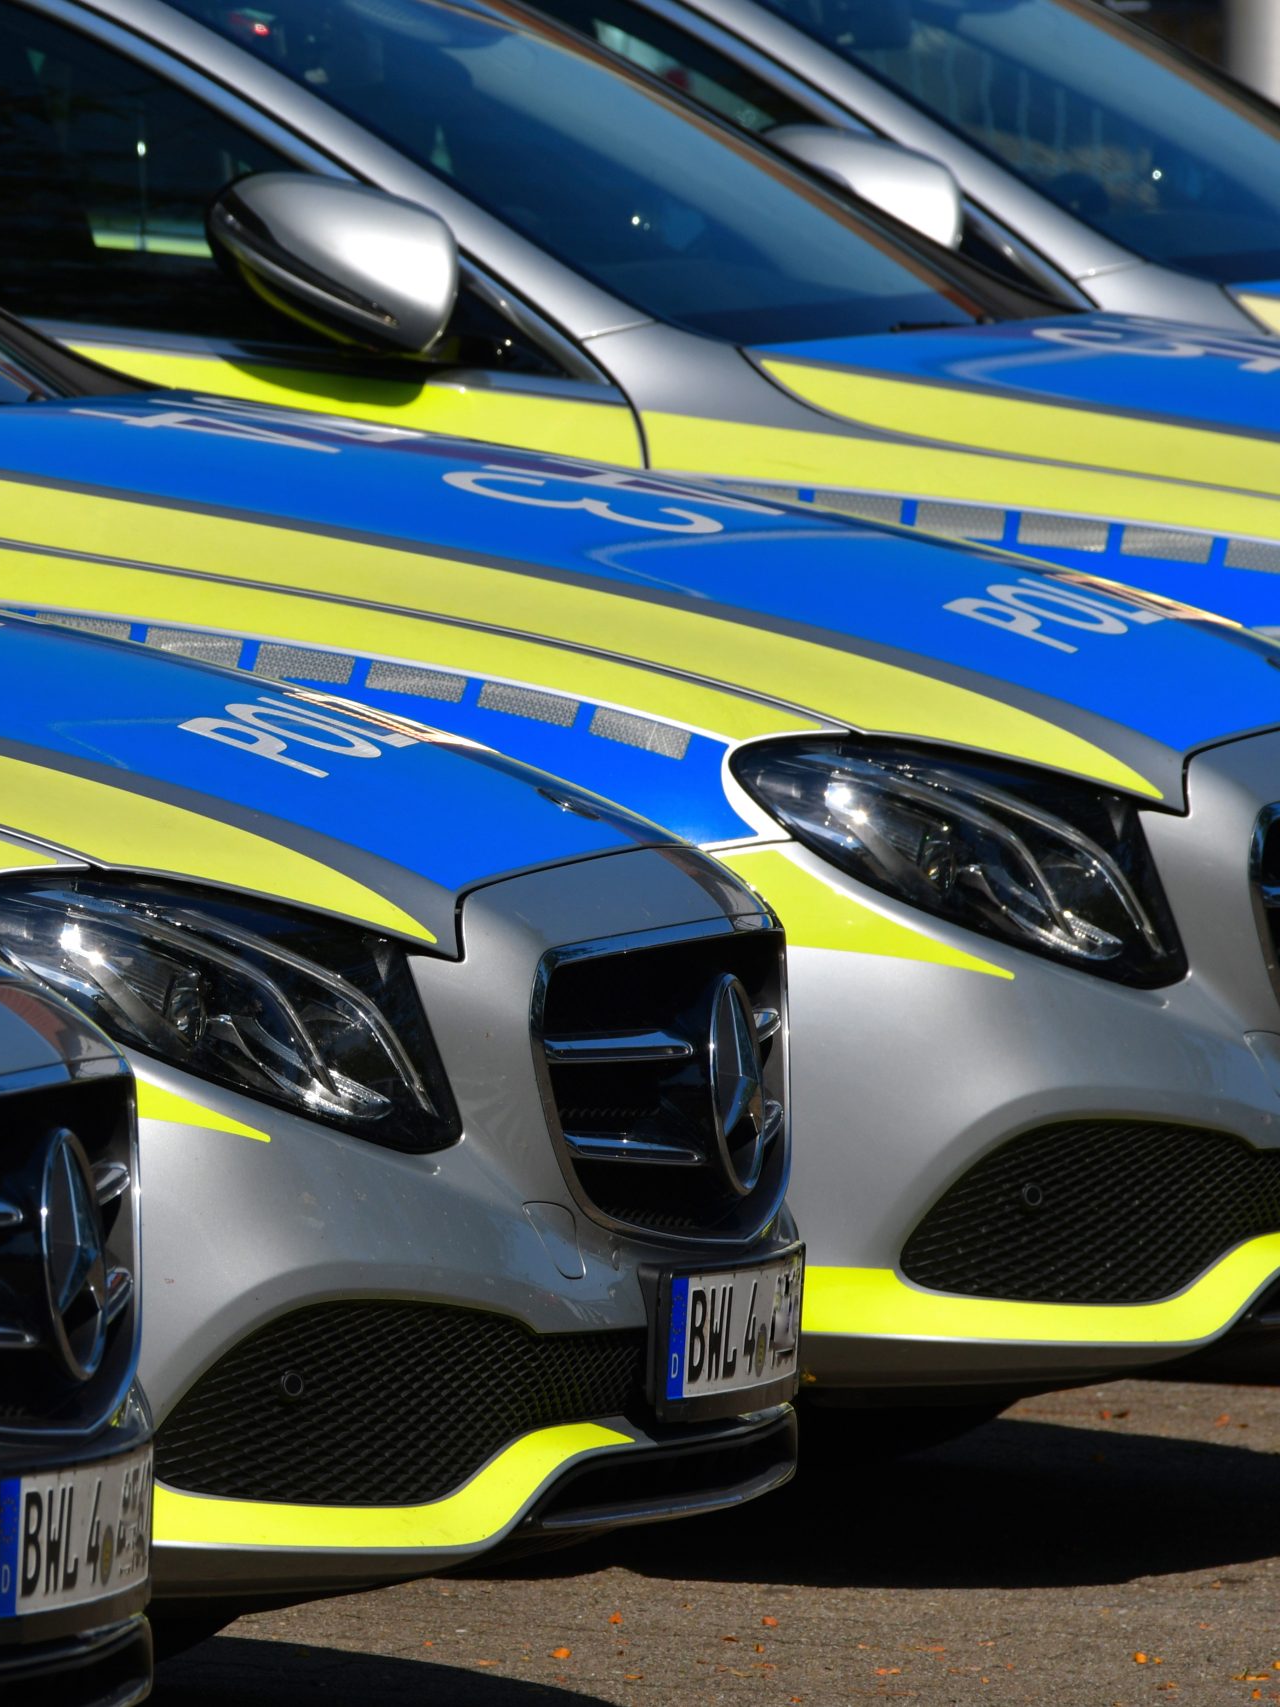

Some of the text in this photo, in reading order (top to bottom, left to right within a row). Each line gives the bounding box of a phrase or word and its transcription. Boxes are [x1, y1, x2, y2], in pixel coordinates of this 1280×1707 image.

[671, 1353, 679, 1378] D
[688, 1285, 737, 1383] BWL
[21, 1485, 79, 1598] BWL
[1, 1565, 10, 1593] D
